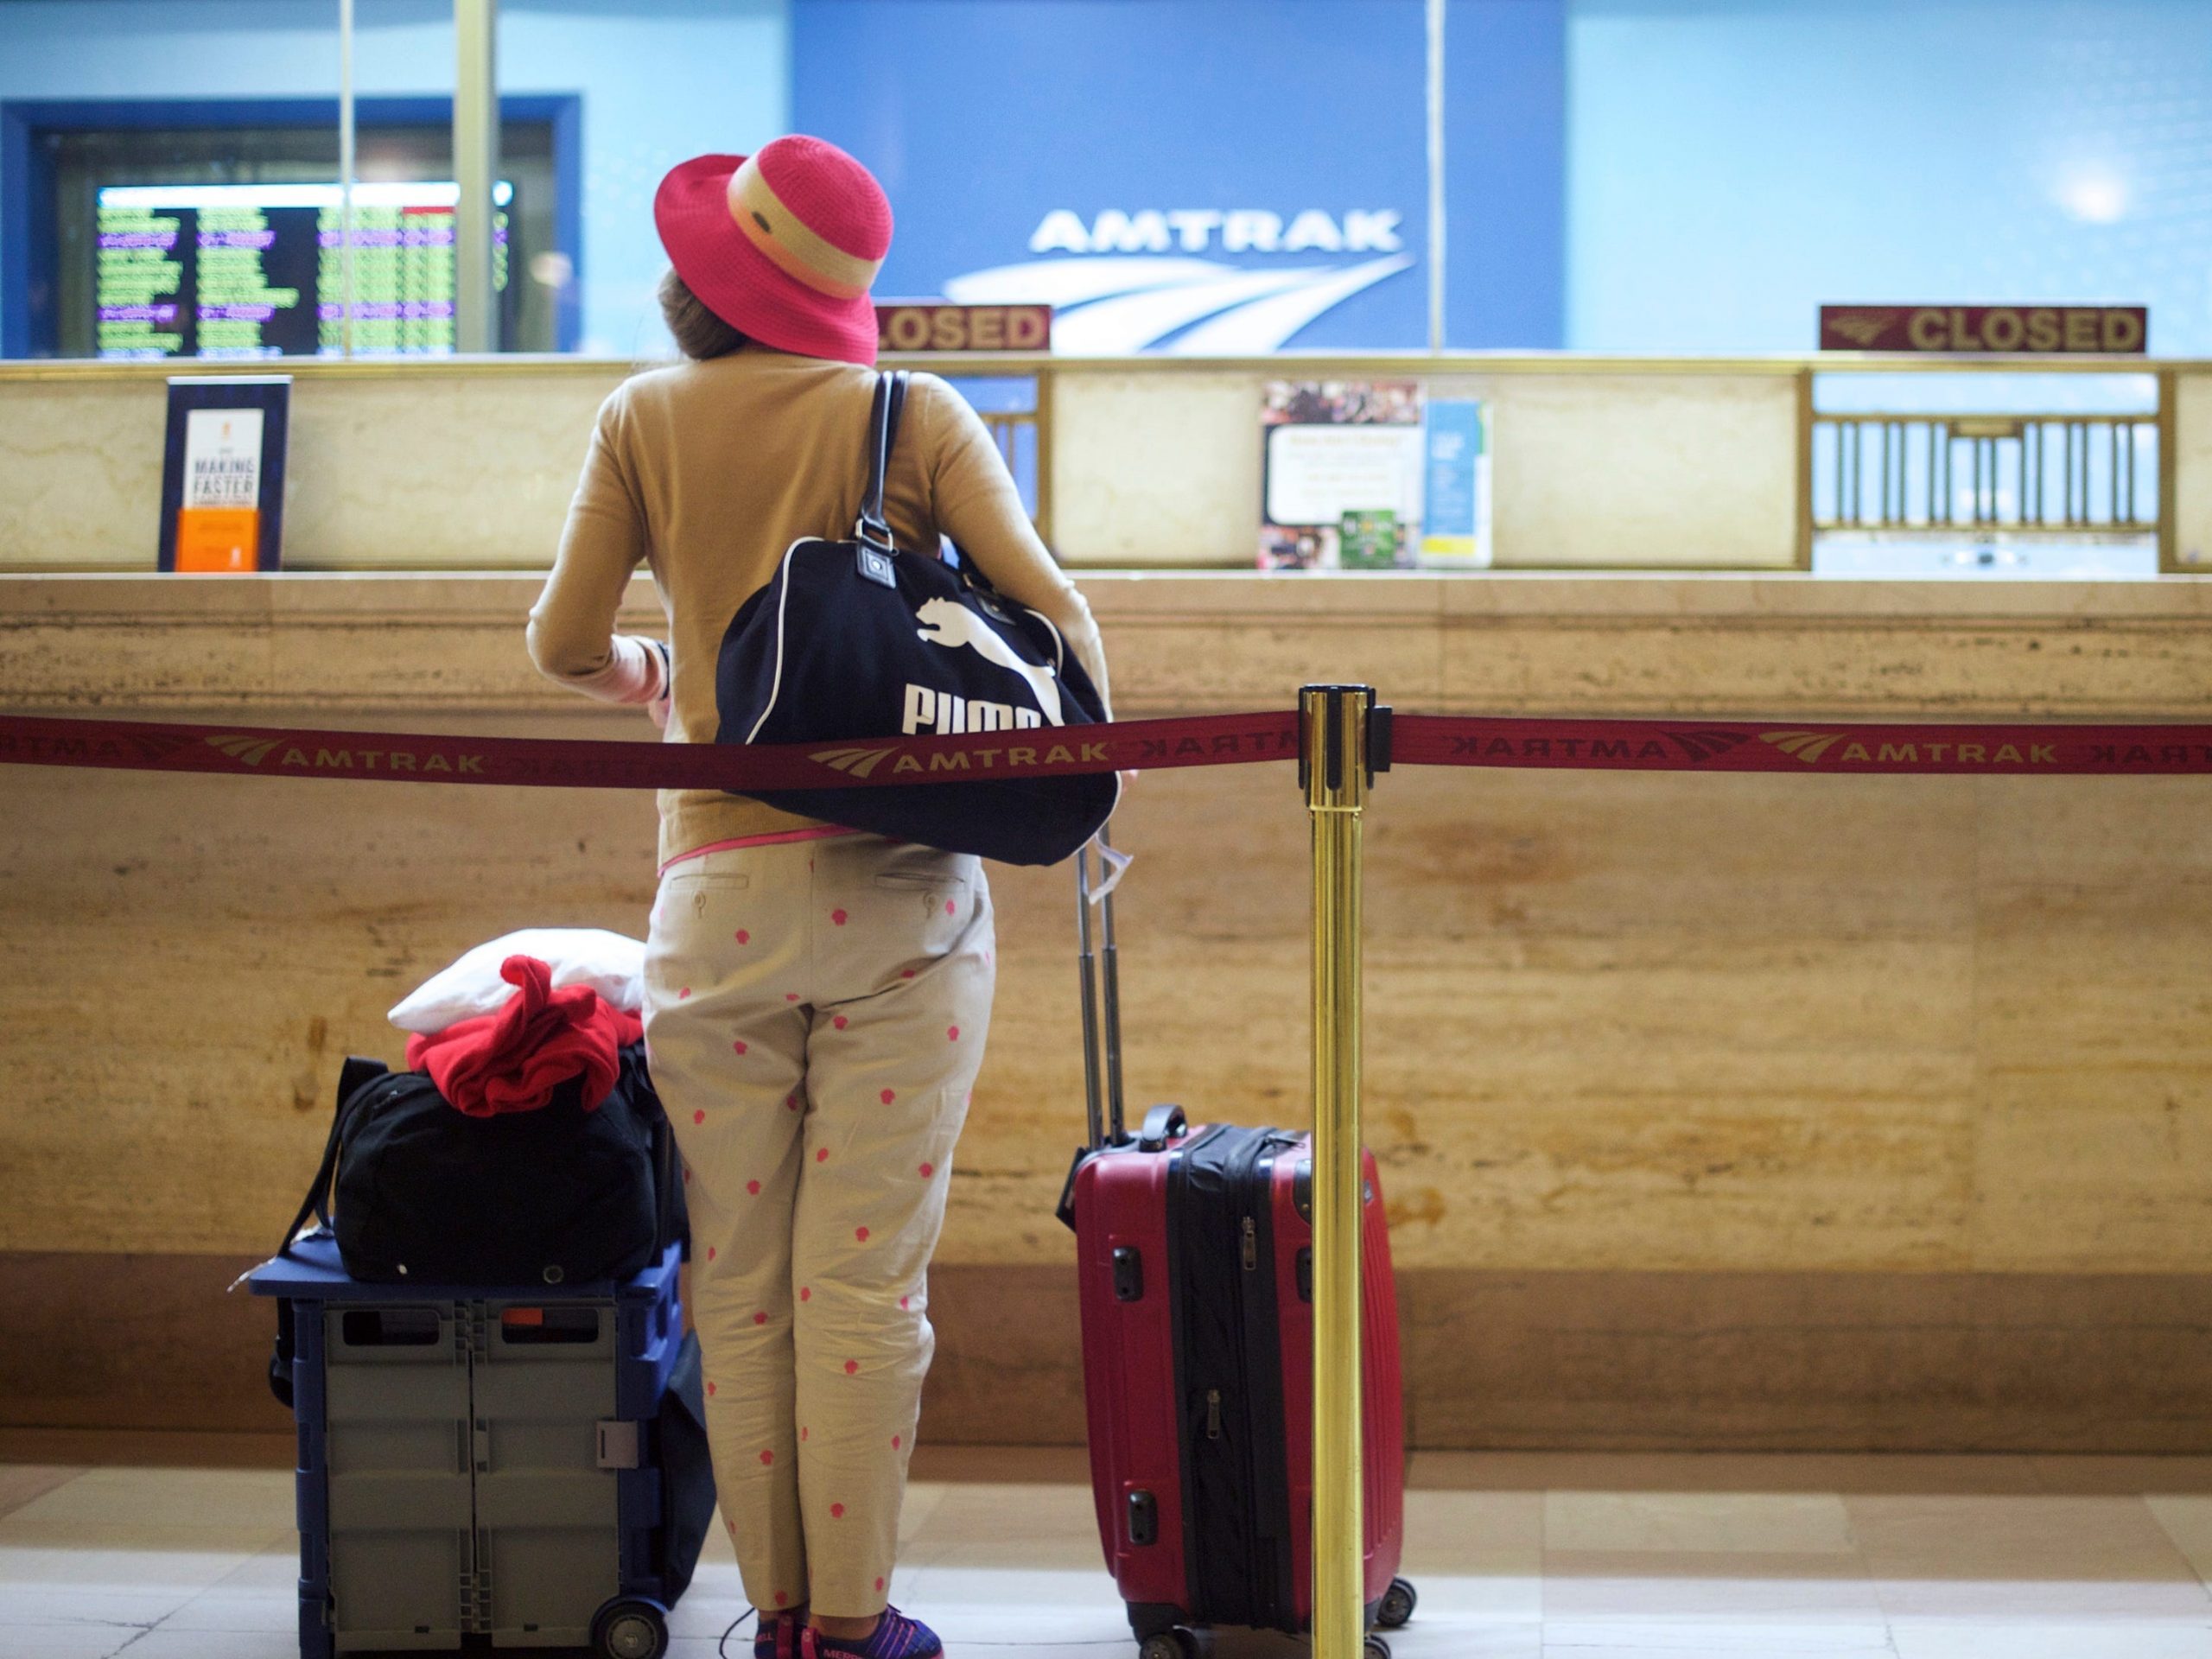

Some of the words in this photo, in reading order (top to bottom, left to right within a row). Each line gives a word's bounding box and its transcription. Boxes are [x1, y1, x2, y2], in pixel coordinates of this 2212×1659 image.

[1028, 209, 1403, 252] AMTRAK
[879, 307, 1046, 349] OSED
[1906, 309, 2142, 351] CLOSED
[281, 748, 487, 773] AMTRAK
[893, 741, 1110, 773] AMTRAK
[1840, 742, 2059, 764] AMTRAK
